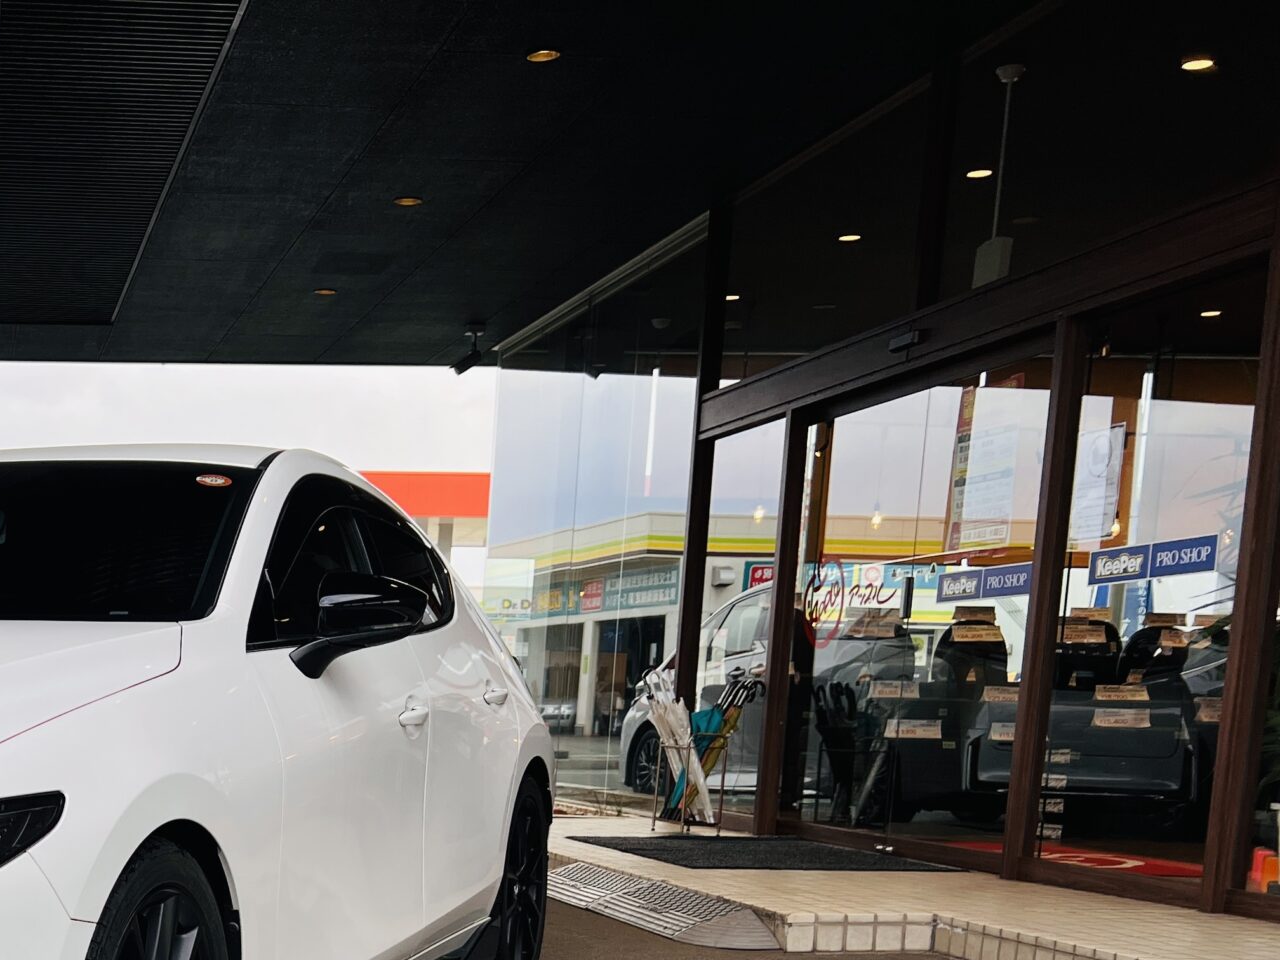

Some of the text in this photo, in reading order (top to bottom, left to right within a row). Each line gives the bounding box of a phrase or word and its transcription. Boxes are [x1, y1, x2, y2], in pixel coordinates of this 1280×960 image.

[1096, 545, 1211, 578] KeePer PRO SHOP
[942, 572, 1028, 597] KeePer PRO SHOP
